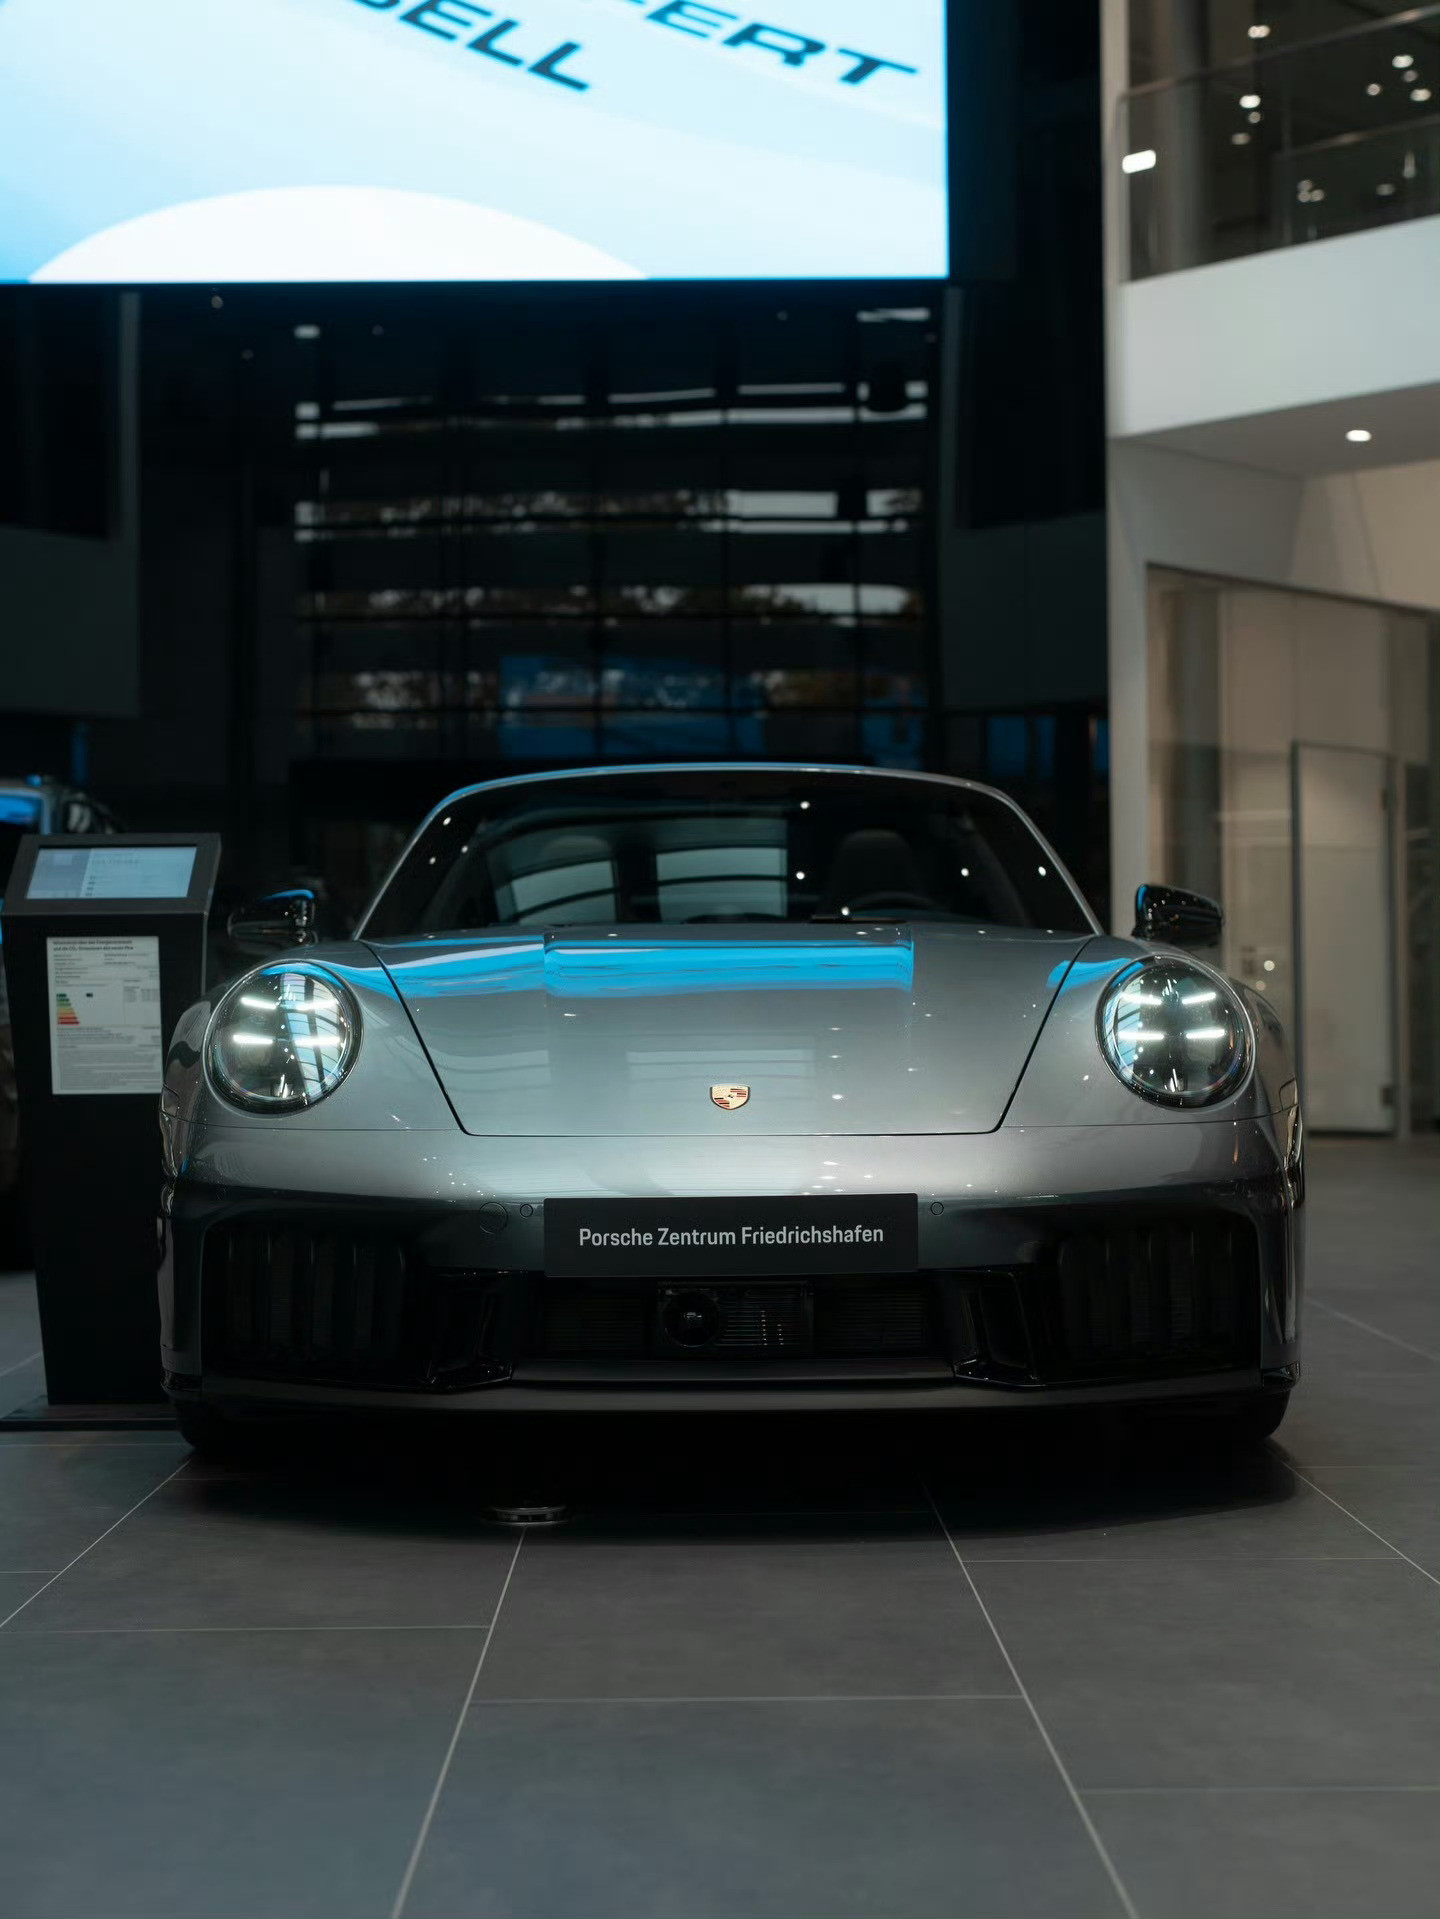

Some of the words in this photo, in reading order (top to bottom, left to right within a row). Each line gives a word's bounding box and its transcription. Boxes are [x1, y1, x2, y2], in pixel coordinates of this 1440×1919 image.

[352, 0, 589, 91] ELL
[626, 0, 917, 85] ERT
[579, 1228, 653, 1246] Porsche
[657, 1227, 736, 1246] Zentrum
[741, 1225, 884, 1245] Friedrichshafen
